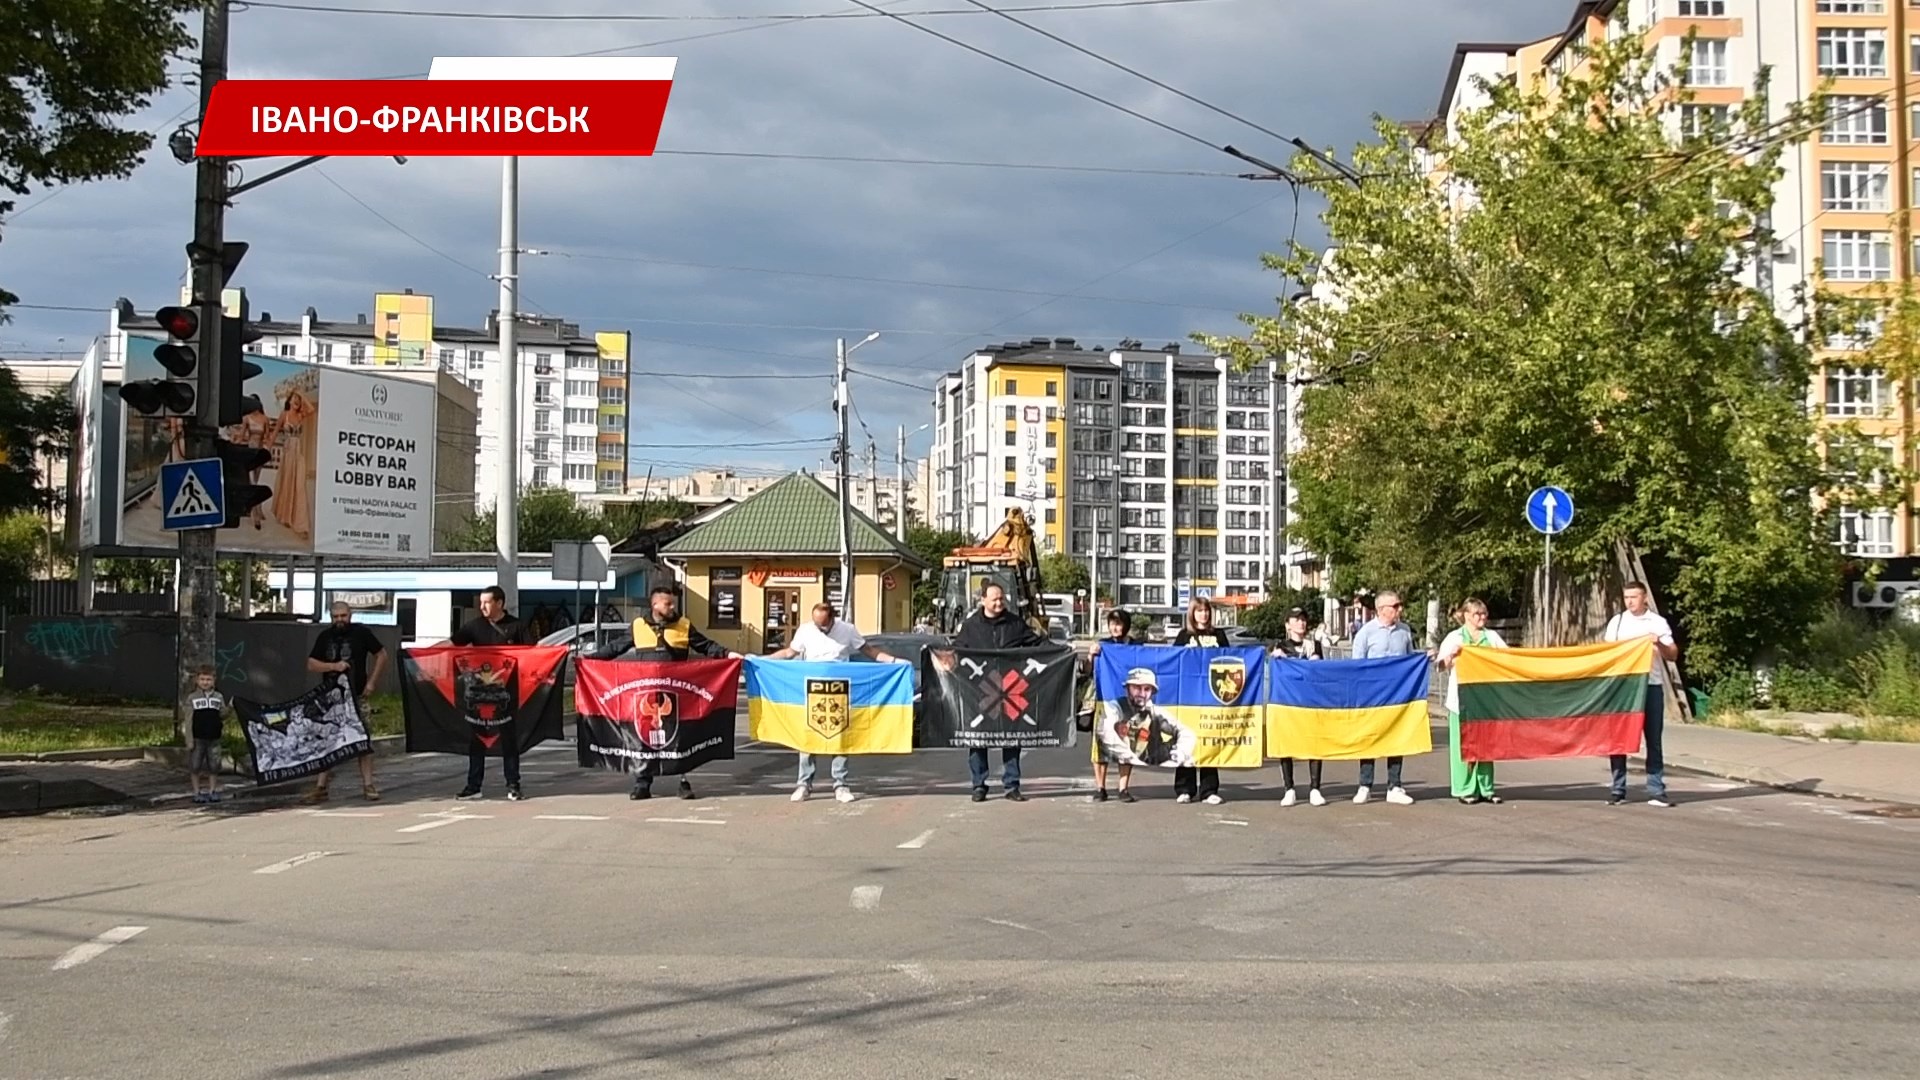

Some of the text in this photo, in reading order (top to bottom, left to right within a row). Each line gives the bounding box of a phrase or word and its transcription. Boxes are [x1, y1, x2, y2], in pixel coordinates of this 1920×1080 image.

[355, 407, 403, 422] OMNIVORE
[338, 431, 416, 453] РЕСТОРАН
[346, 452, 407, 471] SKY BAR
[335, 470, 417, 491] LOBBY BAR
[344, 506, 407, 519] Івано-Франківськ
[362, 499, 389, 508] NADIYA
[390, 501, 417, 511] PALACE
[811, 681, 844, 692] РІЙ
